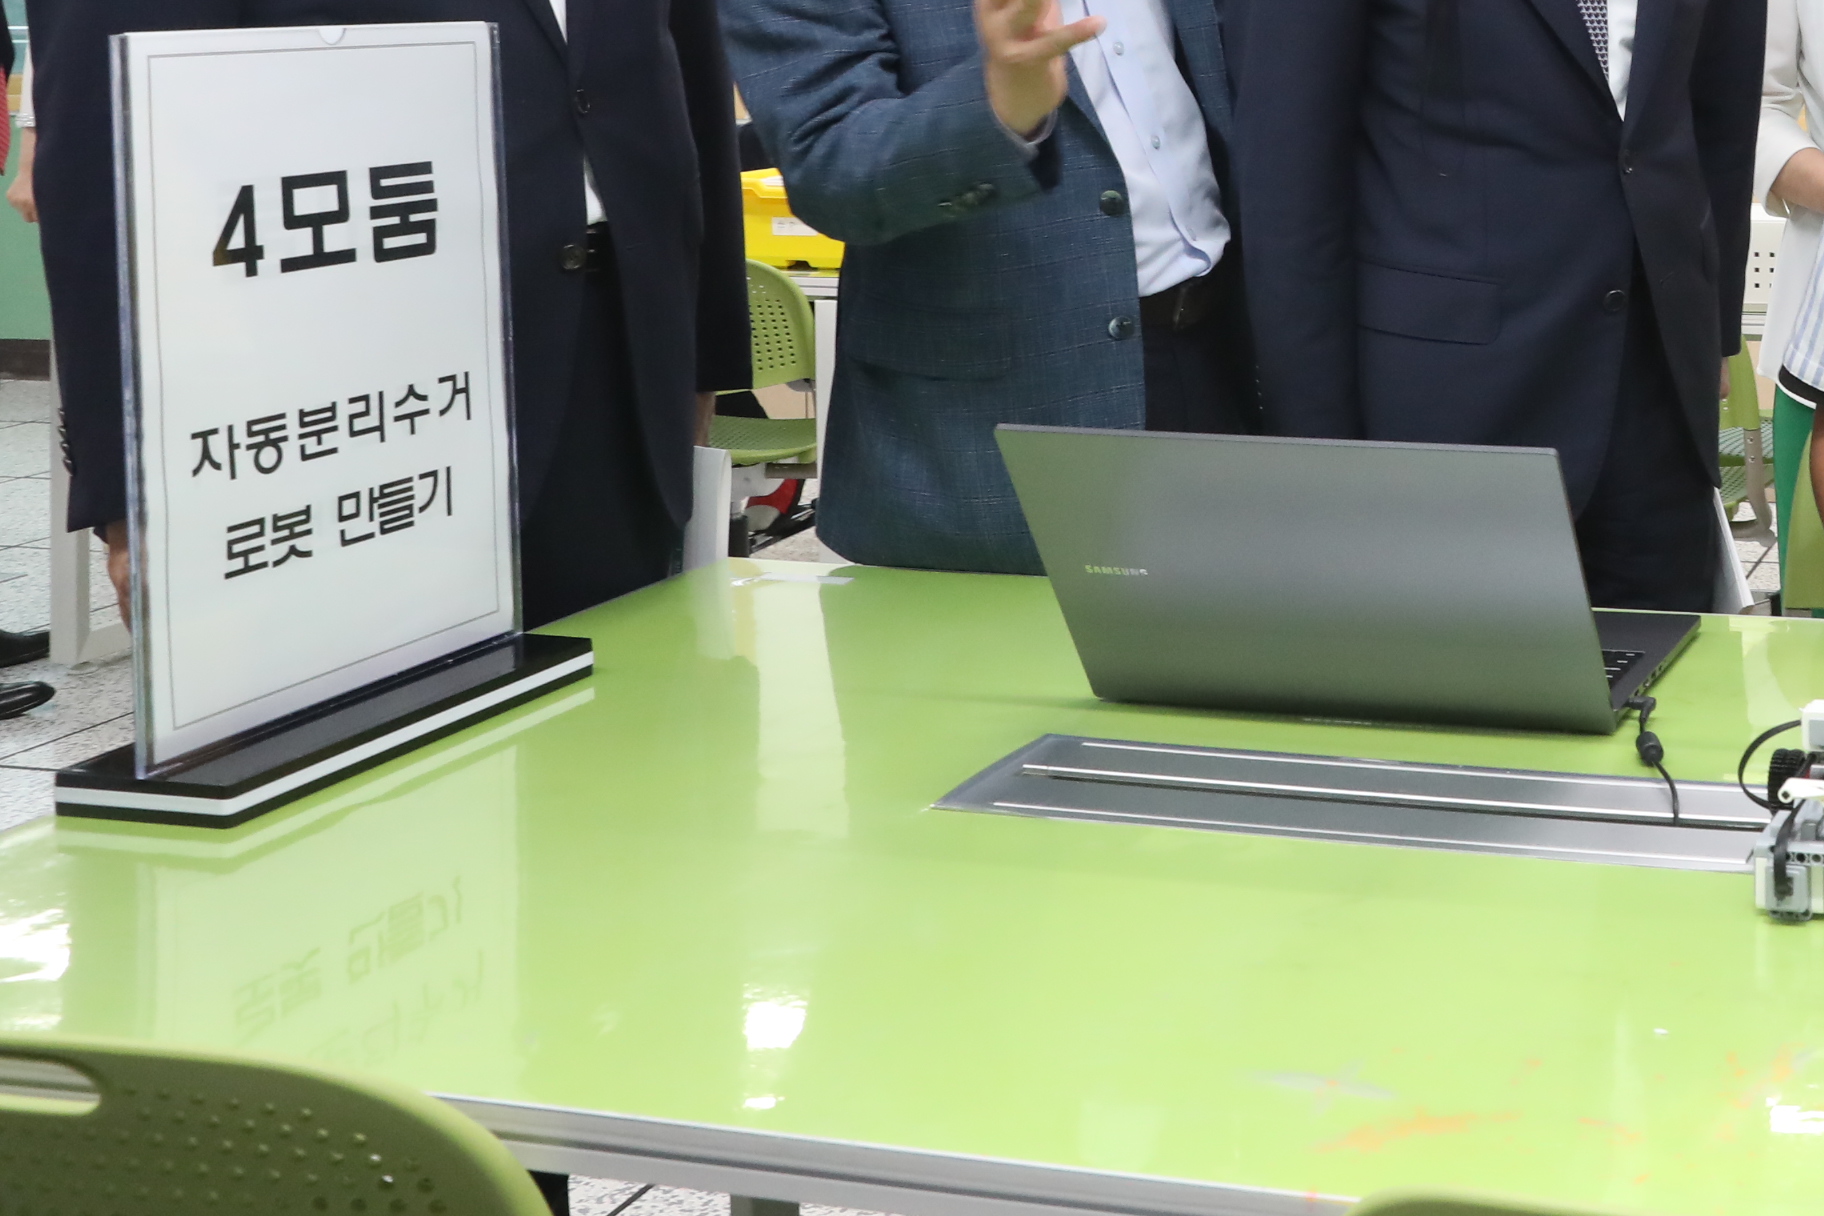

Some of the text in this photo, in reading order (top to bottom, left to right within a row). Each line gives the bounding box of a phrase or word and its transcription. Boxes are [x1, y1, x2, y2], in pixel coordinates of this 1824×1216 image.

[212, 160, 439, 278] 4모둠
[190, 370, 473, 481] 자동분리수거
[223, 466, 454, 580] 로봇 만들기
[1085, 564, 1148, 576] SAMSUNG
